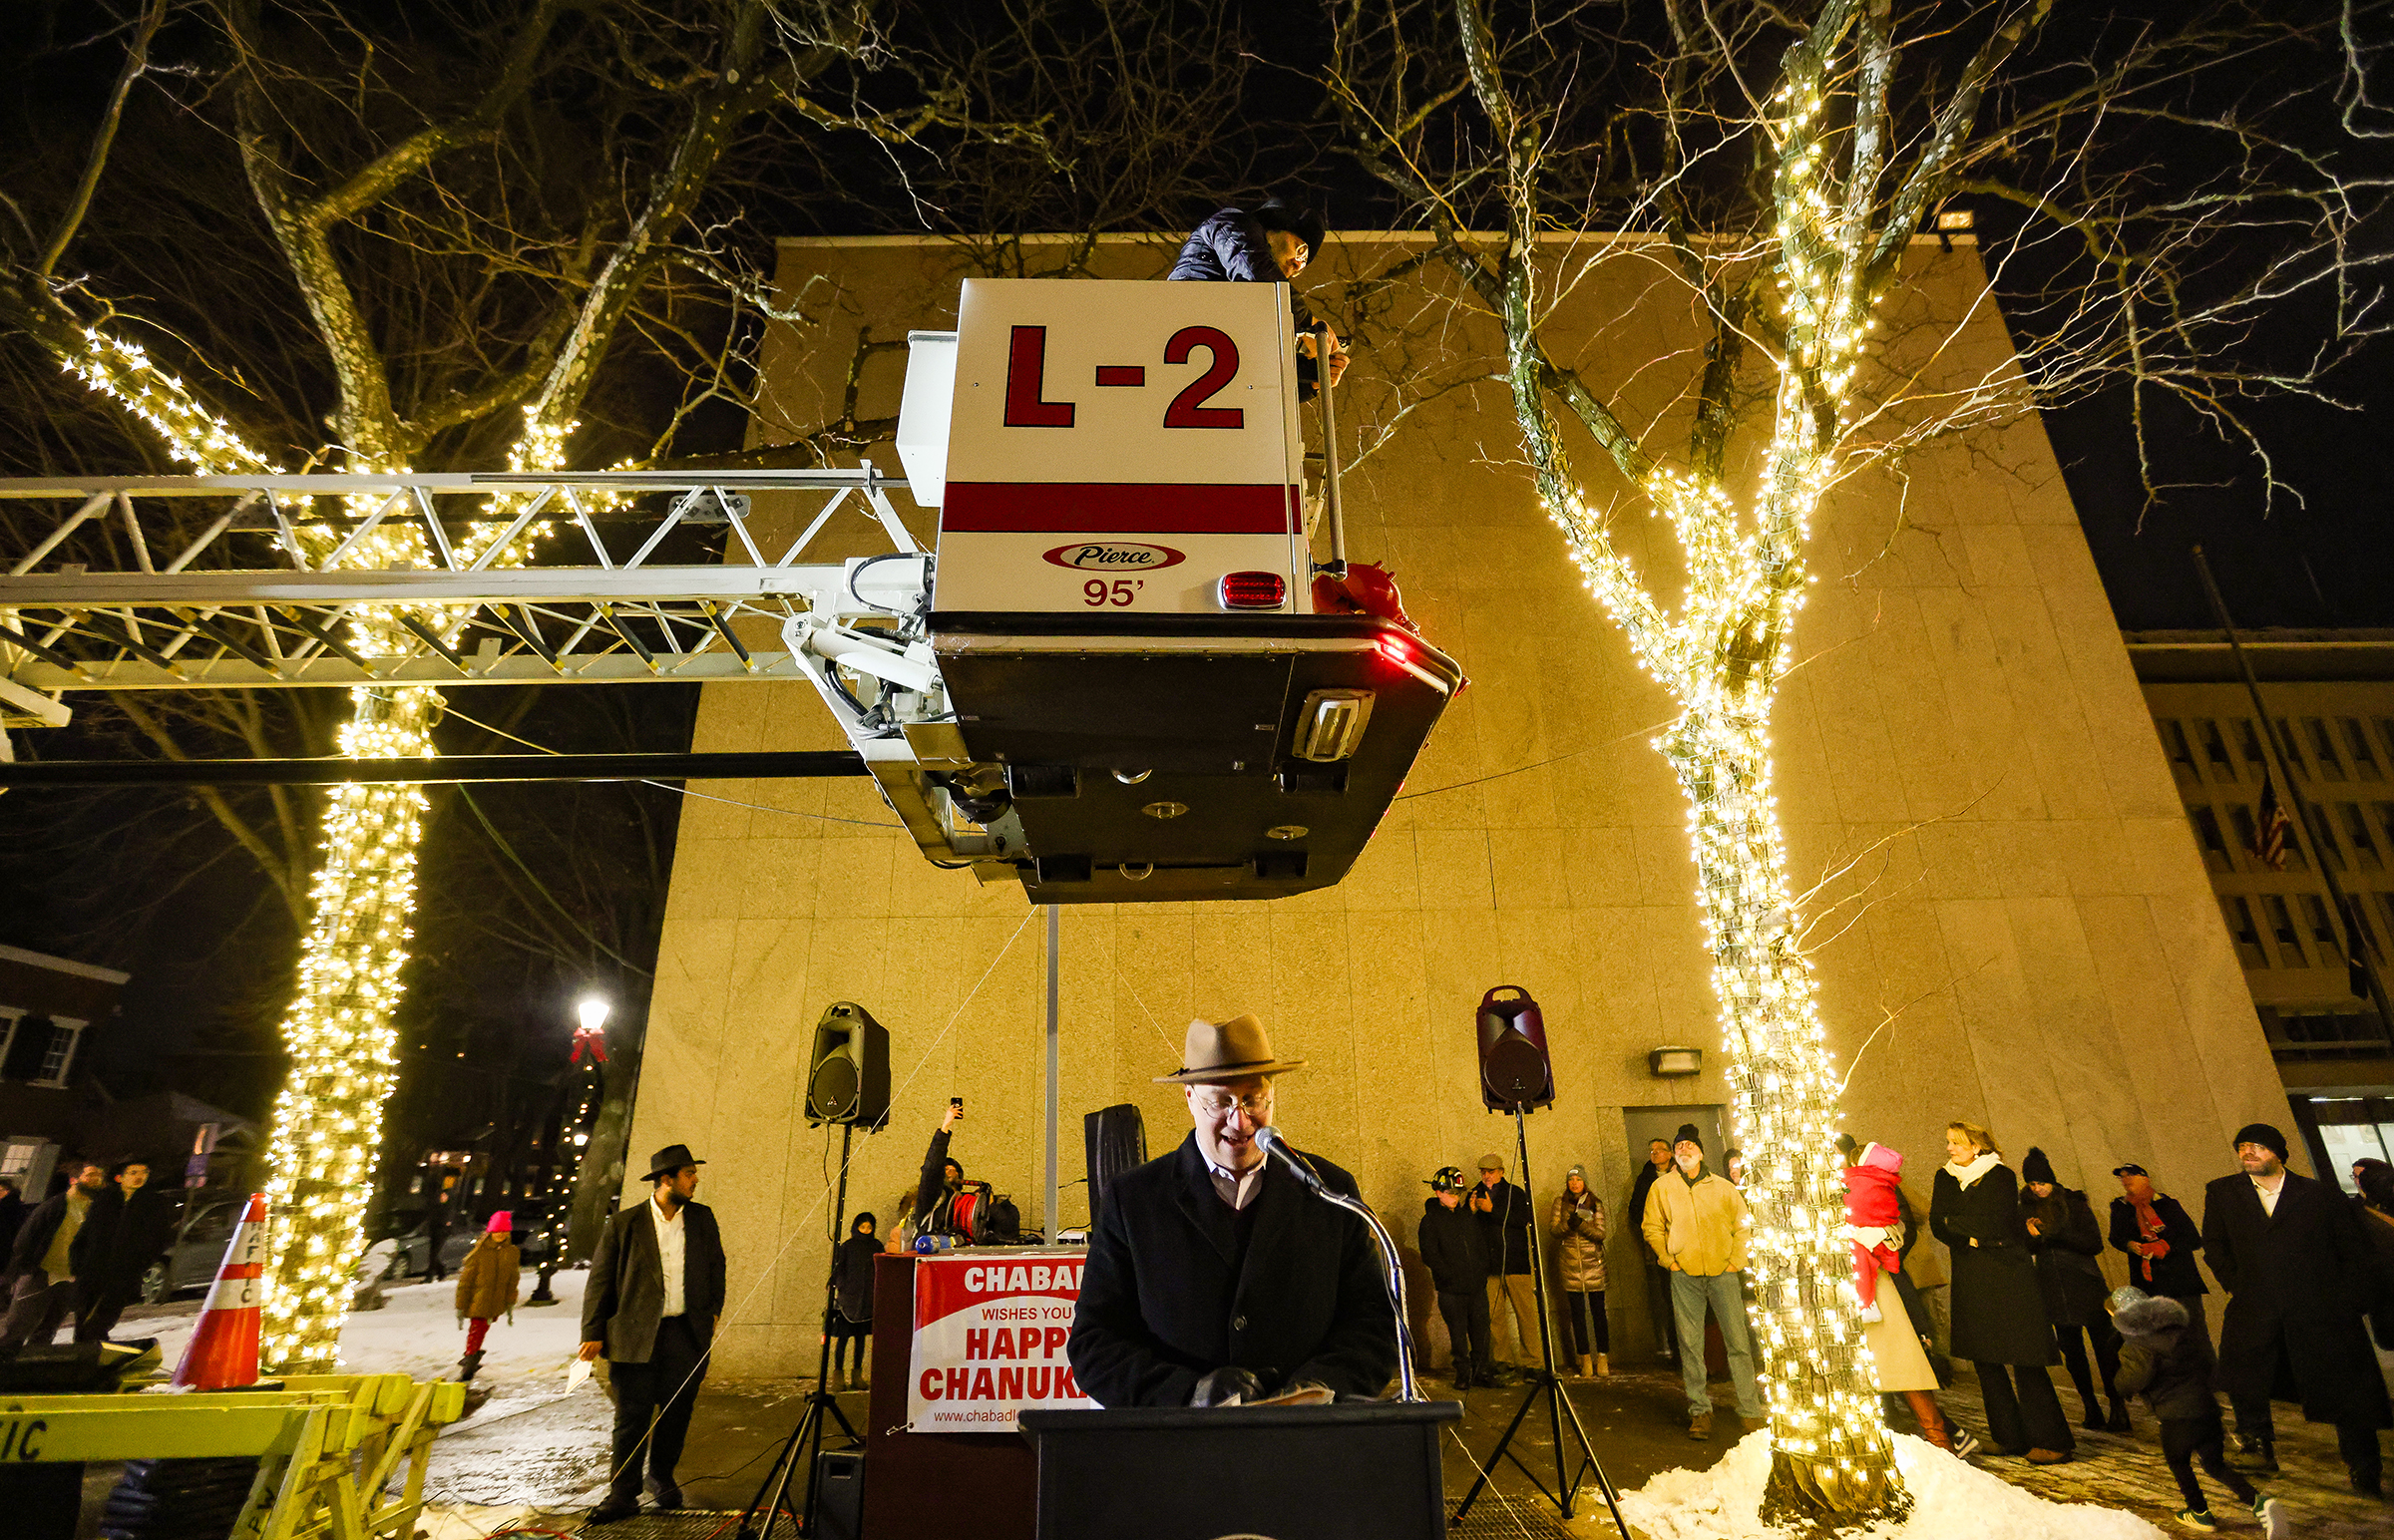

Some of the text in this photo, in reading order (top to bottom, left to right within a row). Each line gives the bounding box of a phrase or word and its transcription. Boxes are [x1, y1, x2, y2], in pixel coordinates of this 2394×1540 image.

[1003, 325, 1244, 429] L-2
[1073, 546, 1154, 566] Pierce
[982, 1307, 1072, 1321] WISHES YOU
[966, 1327, 1073, 1360] HAPP
[920, 1366, 1088, 1401] CHANUK
[934, 1409, 1020, 1422] www.chabadl
[0, 1419, 47, 1461] IC
